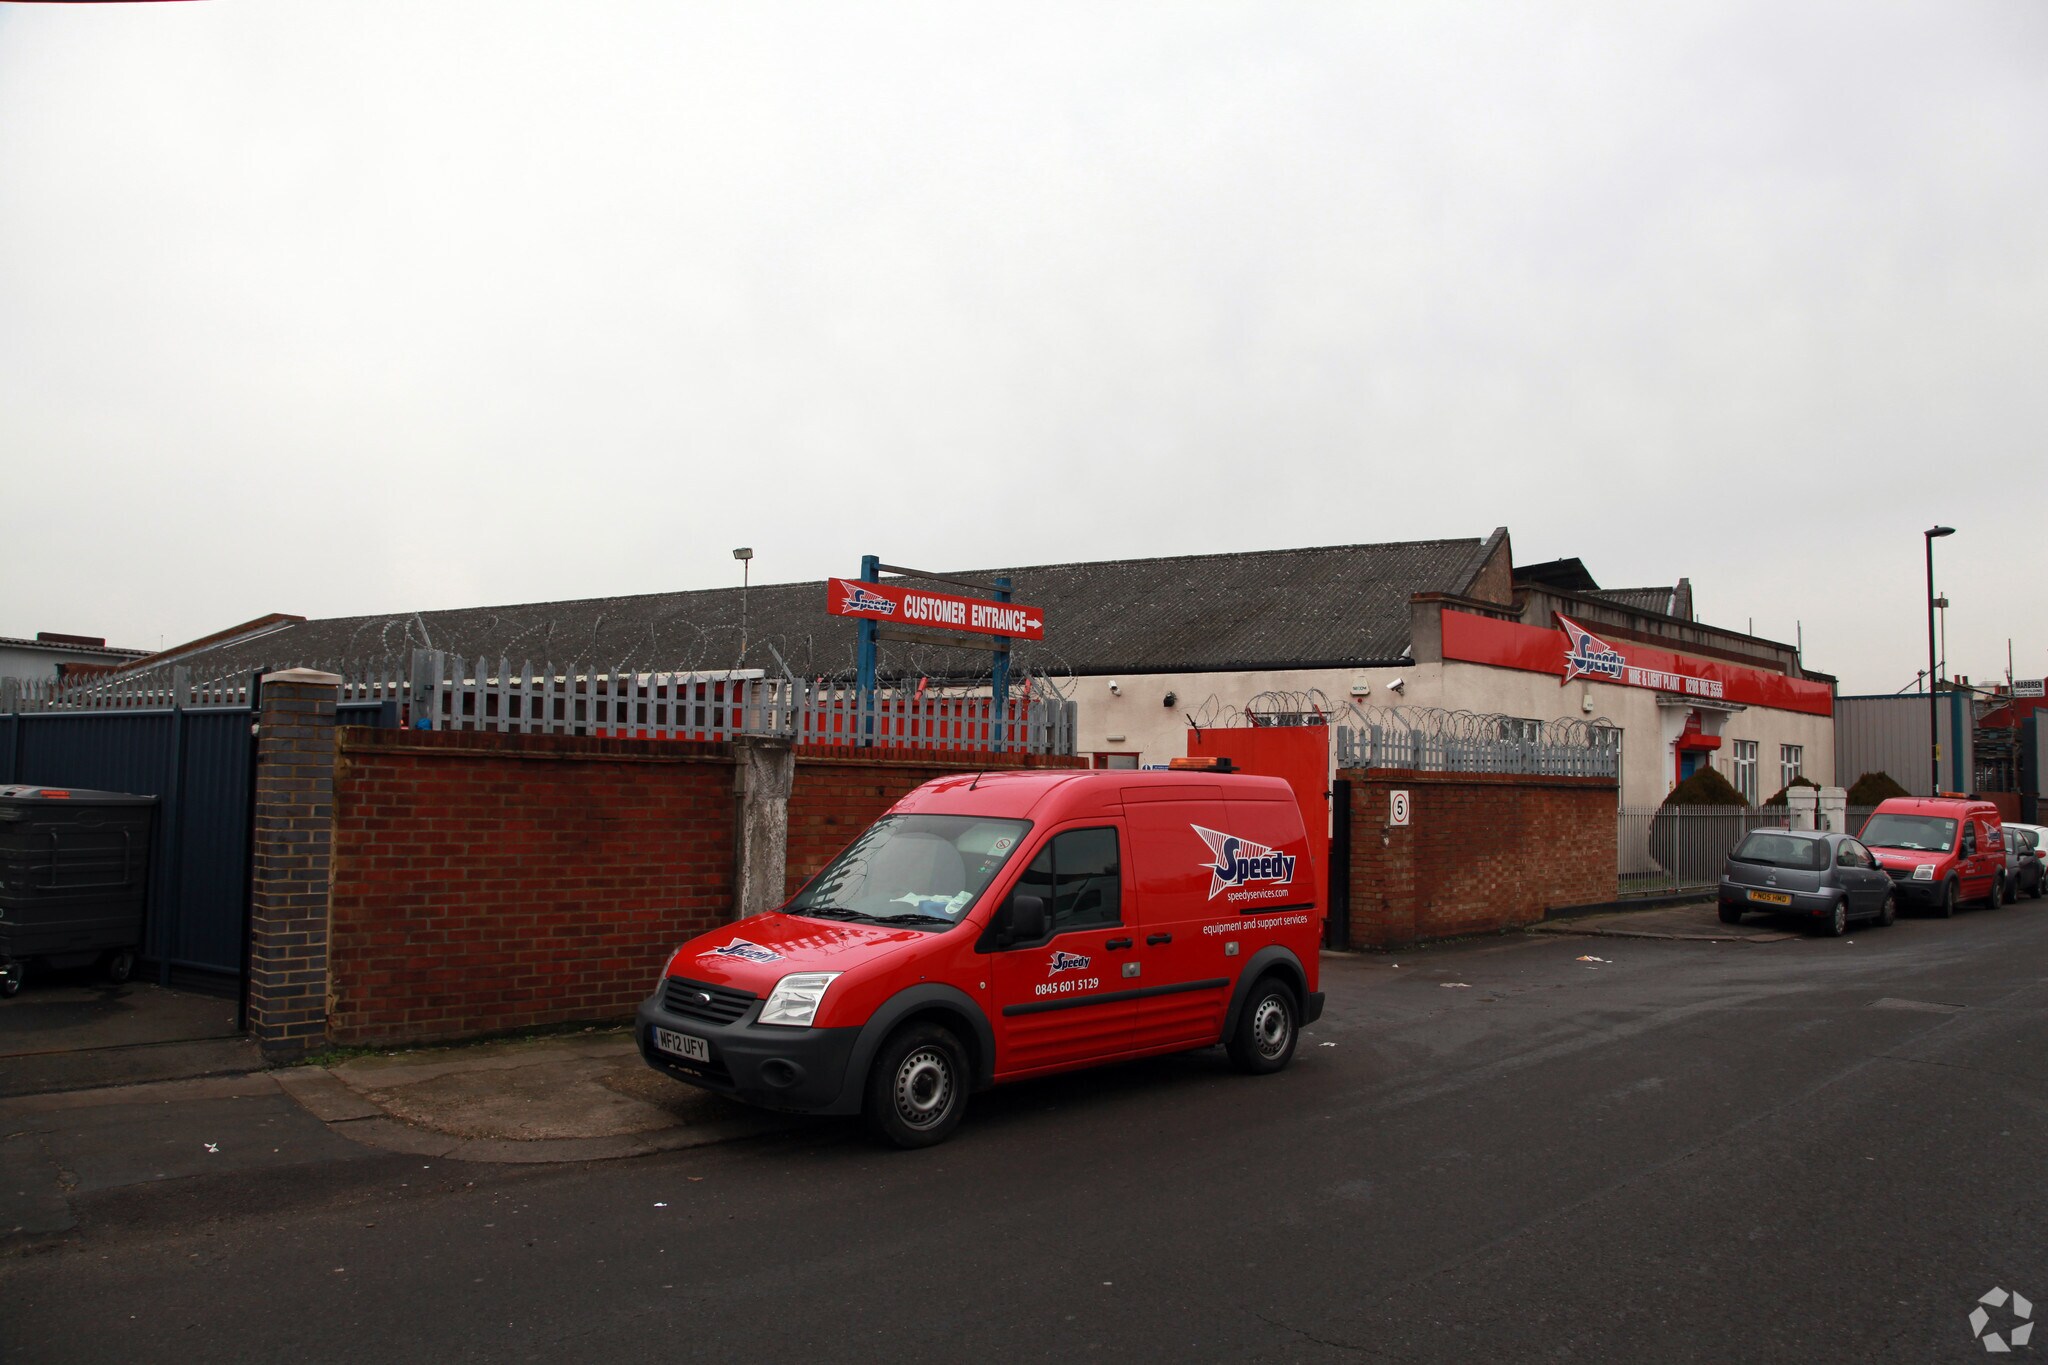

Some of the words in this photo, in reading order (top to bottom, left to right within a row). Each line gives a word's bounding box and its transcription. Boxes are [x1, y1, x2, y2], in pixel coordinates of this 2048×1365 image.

[849, 590, 896, 614] Speedy
[903, 594, 966, 625] CUSTOMER
[971, 604, 1026, 632] ENTRANCE
[1571, 634, 1625, 679] Speedy
[1628, 669, 1641, 685] HIRE
[1642, 671, 1647, 686] &
[1647, 672, 1662, 689] LIGHT
[1663, 675, 1680, 691] PLANT
[1397, 801, 1403, 815] 5
[1215, 837, 1296, 885] Speedy
[1227, 888, 1289, 902] speedyservices.com
[1203, 920, 1241, 936] equipment
[1243, 918, 1257, 930] and
[1257, 915, 1283, 930] support
[1284, 914, 1308, 926] services
[1053, 952, 1091, 970] Speedy
[1035, 982, 1058, 995] 0845
[1059, 980, 1075, 992] 601
[1077, 977, 1099, 990] 5129
[683, 1037, 704, 1058] UFY
